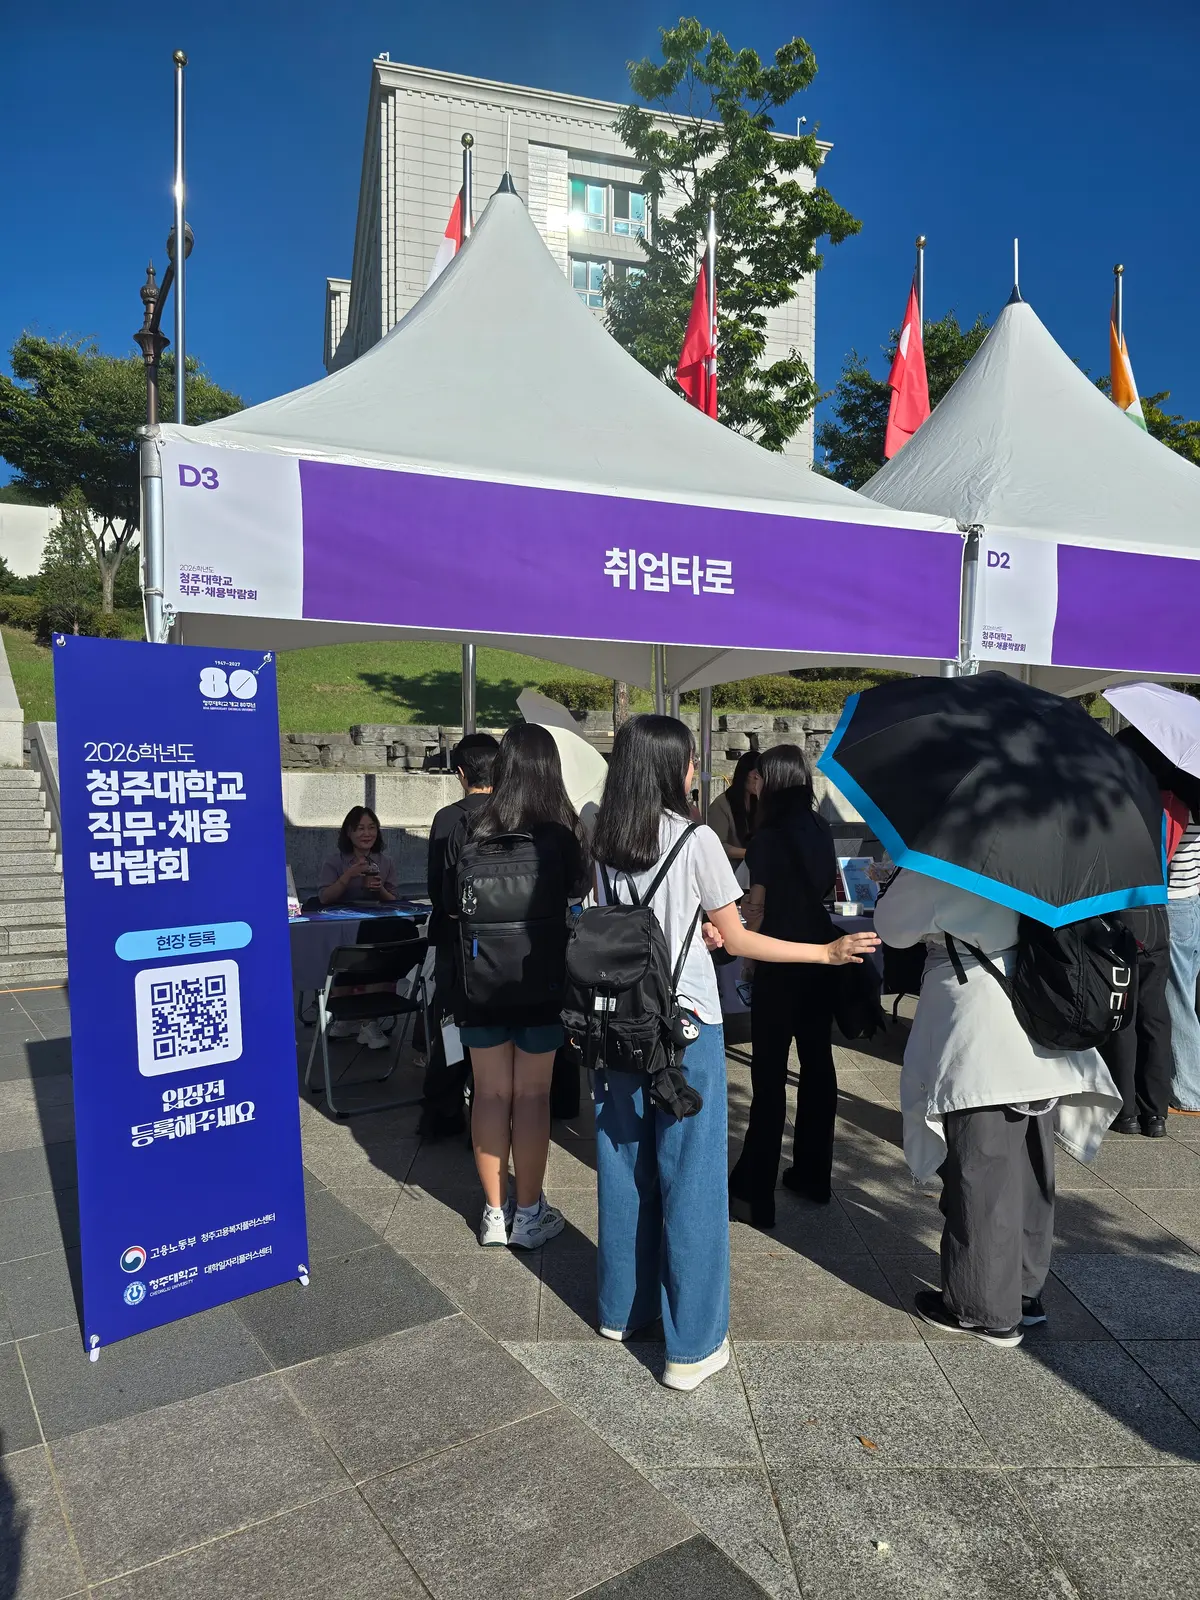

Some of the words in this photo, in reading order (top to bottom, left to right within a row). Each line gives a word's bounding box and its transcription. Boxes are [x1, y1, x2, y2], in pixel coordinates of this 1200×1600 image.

[178, 464, 220, 490] D3
[179, 564, 214, 573] 2026학년도
[603, 547, 735, 596] 취업타로
[987, 550, 1011, 569] D2
[179, 572, 233, 586] 청주대학교
[179, 584, 258, 601] 직무·채용박람회
[982, 631, 1013, 641] 청주대학교
[84, 742, 196, 763] 2026학년도
[86, 769, 247, 806] 청주대학교
[87, 809, 231, 847] 직무·채용
[89, 847, 190, 887] 박람회
[156, 933, 186, 952] 현장
[187, 930, 216, 946] 등록
[162, 1079, 225, 1112] 입장전
[131, 1101, 256, 1148] 등록해주세요
[150, 1236, 197, 1259] 고용노동부
[200, 1212, 276, 1243] 청주고용복지플러스센터
[148, 1266, 199, 1290] 청주대학교
[204, 1245, 273, 1274] 대학일자리플러스센터
[171, 1278, 195, 1290] UNIVERSITY
